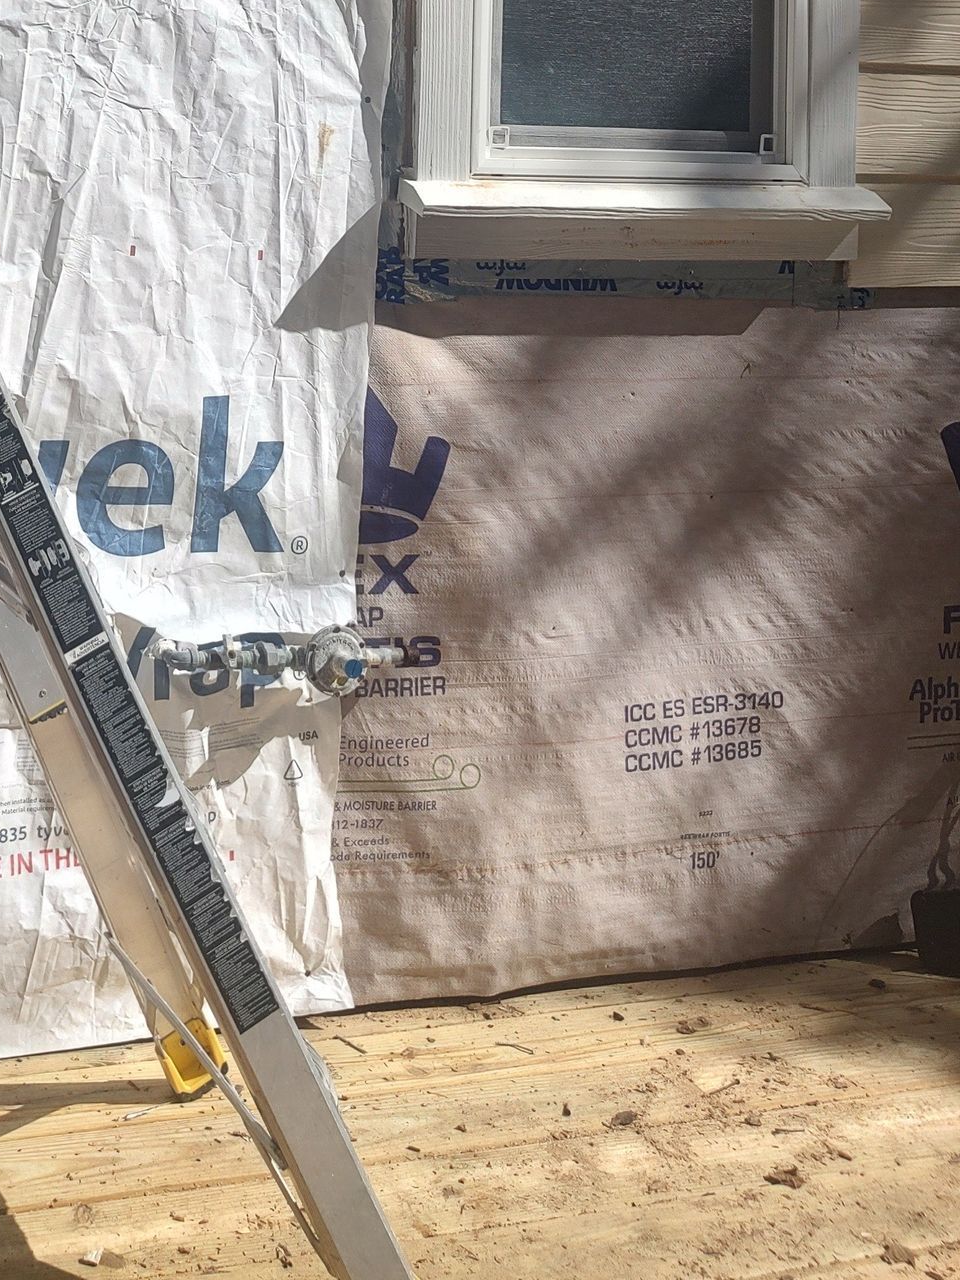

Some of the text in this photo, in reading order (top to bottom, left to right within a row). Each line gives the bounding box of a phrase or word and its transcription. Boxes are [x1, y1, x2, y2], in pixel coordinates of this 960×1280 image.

[355, 676, 446, 698] BARRIER
[624, 690, 784, 723] ICC ES ESR-3140
[299, 730, 319, 741] USA
[624, 716, 761, 748] CCMC #13678
[340, 734, 430, 752] Engineered
[340, 753, 410, 767] Products
[624, 740, 762, 772] CCMC #13685
[1, 806, 26, 816] Material
[343, 801, 394, 811] MOISTURE
[398, 800, 437, 811] BARRIER
[344, 836, 389, 846] Exceeds
[10, 851, 33, 877] IN
[355, 851, 430, 862] Requirements
